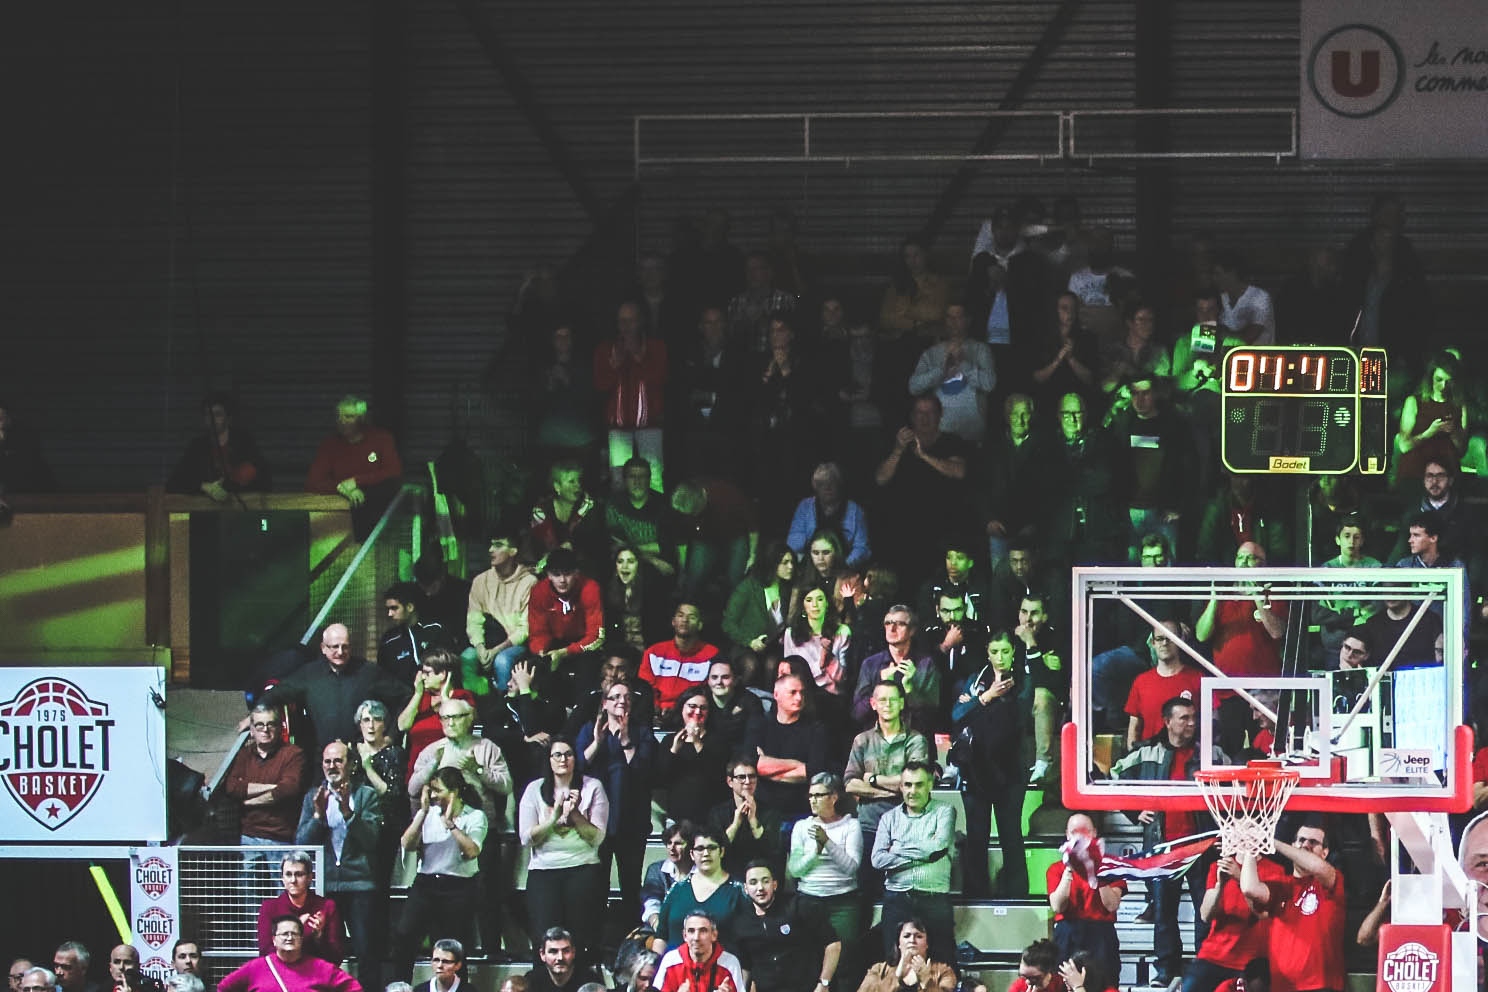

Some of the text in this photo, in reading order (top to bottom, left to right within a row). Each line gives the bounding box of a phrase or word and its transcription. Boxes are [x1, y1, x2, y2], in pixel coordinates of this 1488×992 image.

[1331, 51, 1380, 97] U
[1271, 458, 1308, 470] Bodet
[1403, 755, 1430, 766] Jeep
[1405, 766, 1429, 774] ELITE
[20, 775, 88, 796] BASKET
[136, 869, 172, 884] CHOLET
[137, 919, 173, 934] CHOLET
[1384, 960, 1439, 981] CHOLET
